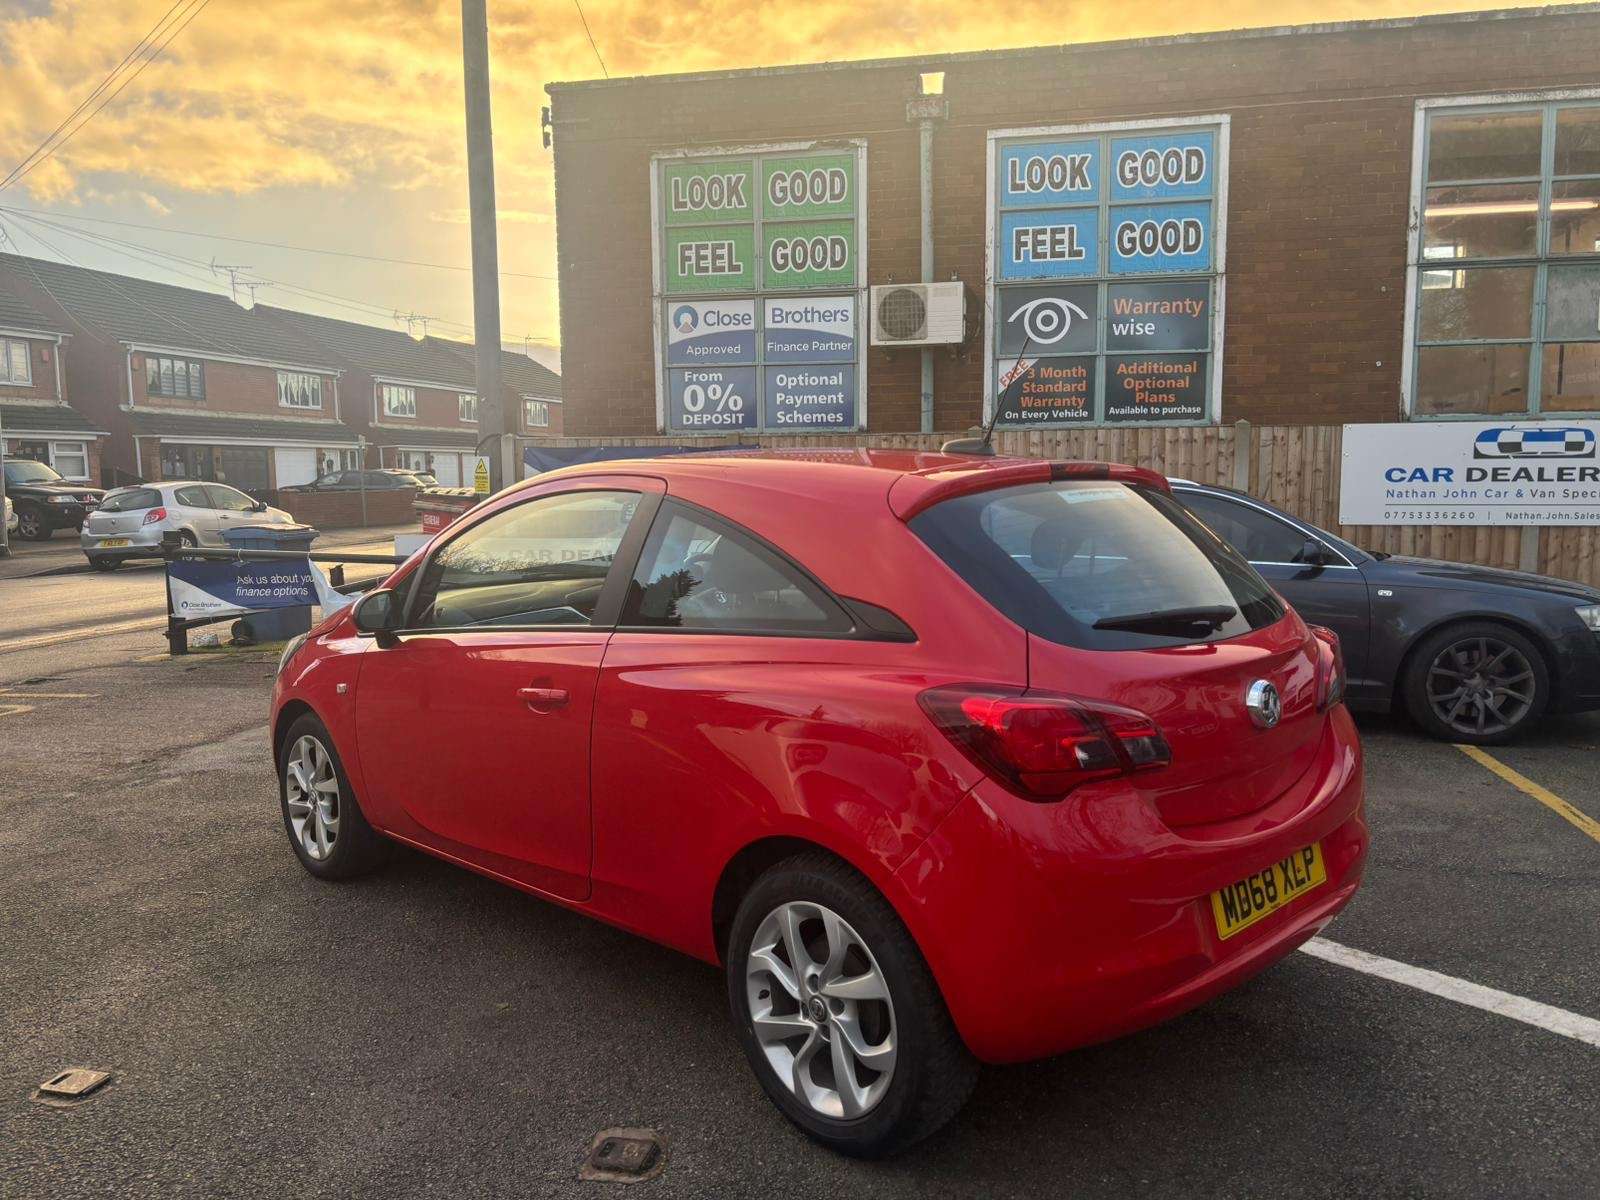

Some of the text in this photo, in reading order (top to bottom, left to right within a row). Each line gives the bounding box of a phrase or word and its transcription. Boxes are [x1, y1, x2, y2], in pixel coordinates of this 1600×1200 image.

[1008, 146, 1206, 194] LOOK GOOD
[671, 168, 848, 212] LOOK GOOD
[1013, 218, 1204, 263] FEEL GOOD
[678, 236, 848, 276] FEEL GOOD
[1114, 298, 1203, 318] Warranty
[703, 306, 850, 326] Close Brothers
[1112, 319, 1155, 336] wise
[686, 341, 852, 356] Approved Finance Partner
[1027, 366, 1087, 379] 3 Month
[1116, 361, 1197, 375] Additional
[684, 371, 723, 382] From
[776, 372, 843, 389] Optional
[1123, 376, 1189, 391] Optional
[1022, 381, 1087, 393] Standard
[683, 383, 743, 412] 0%
[776, 392, 844, 407] Payment
[1020, 396, 1086, 410] Warranty
[1136, 391, 1176, 403] Plans
[776, 410, 844, 423] Schemes
[1005, 409, 1088, 420] On Every Vehicle
[1109, 405, 1202, 415] Available to purchase
[682, 413, 745, 425] DEPOSIT
[1385, 467, 1600, 483] CAR DEALER
[1386, 488, 1600, 500] Nathan John Car & Van Spec
[236, 574, 254, 585] Ask
[256, 576, 268, 584] us
[270, 573, 299, 584] about
[236, 586, 308, 597] finance options
[1220, 845, 1314, 928] MD68 XLP
